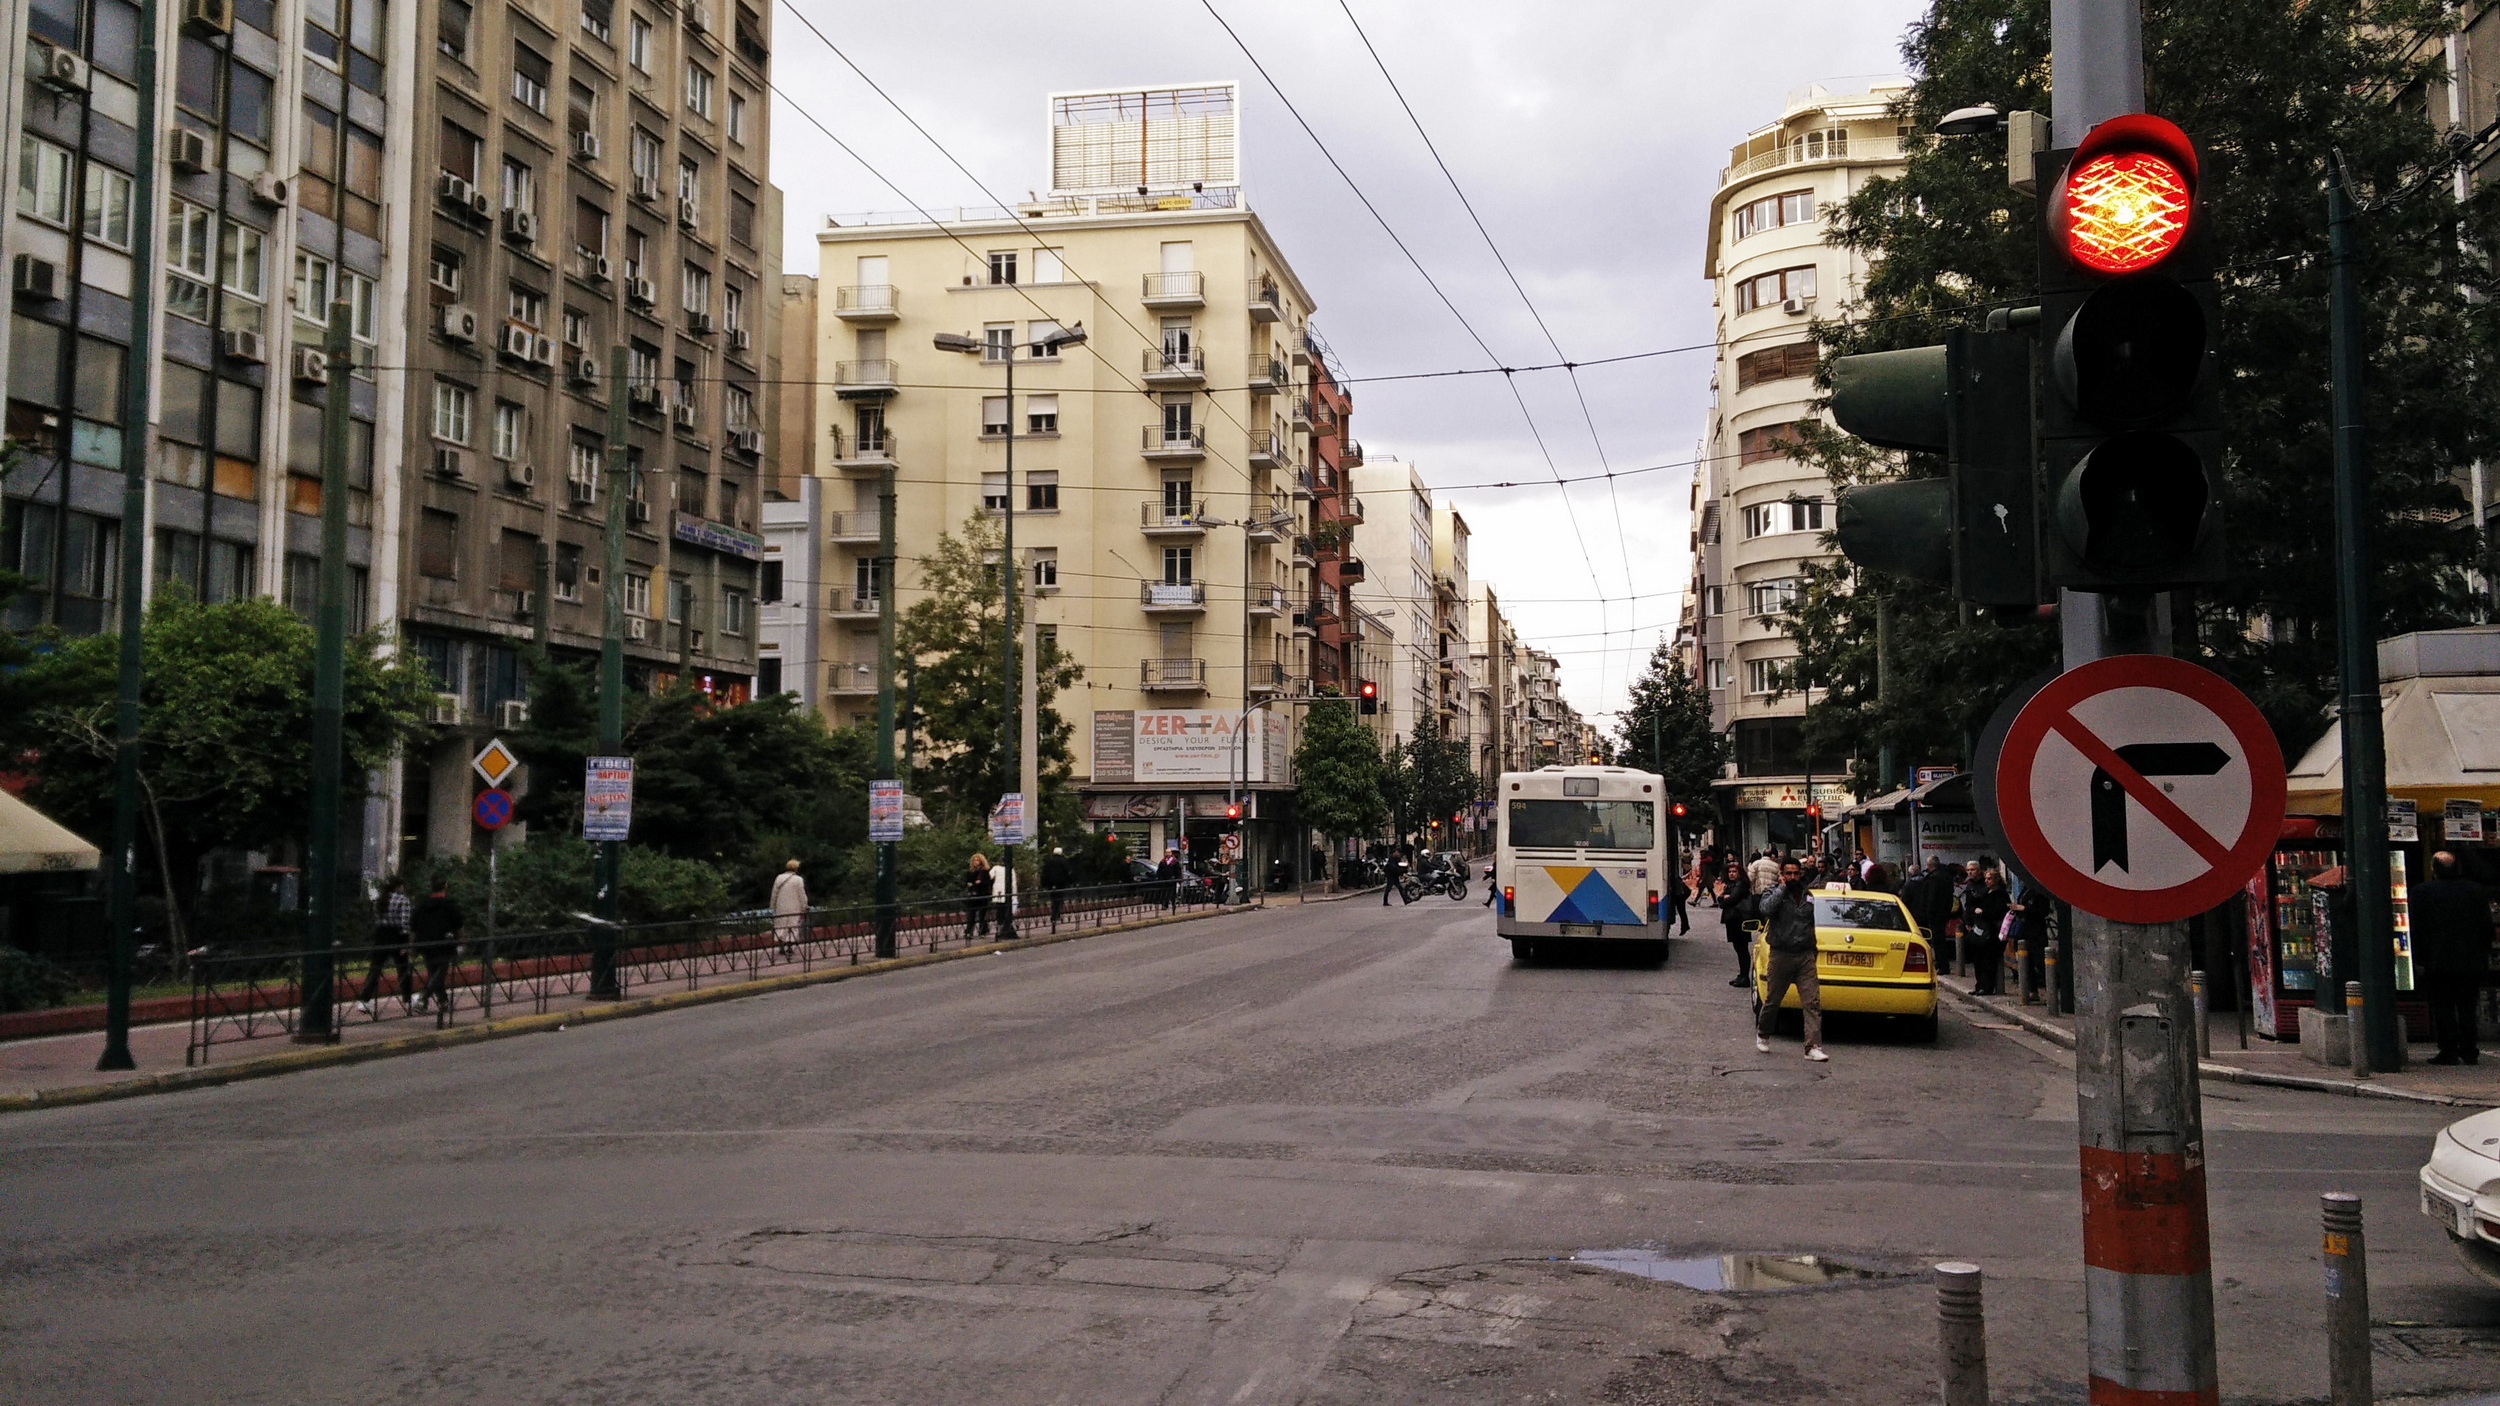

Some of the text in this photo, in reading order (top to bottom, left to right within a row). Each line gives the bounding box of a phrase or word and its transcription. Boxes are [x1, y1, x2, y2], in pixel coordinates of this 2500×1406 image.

[1139, 737, 1173, 745] DESIGN
[1184, 736, 1210, 744] YOUR
[1511, 802, 1526, 810] 594
